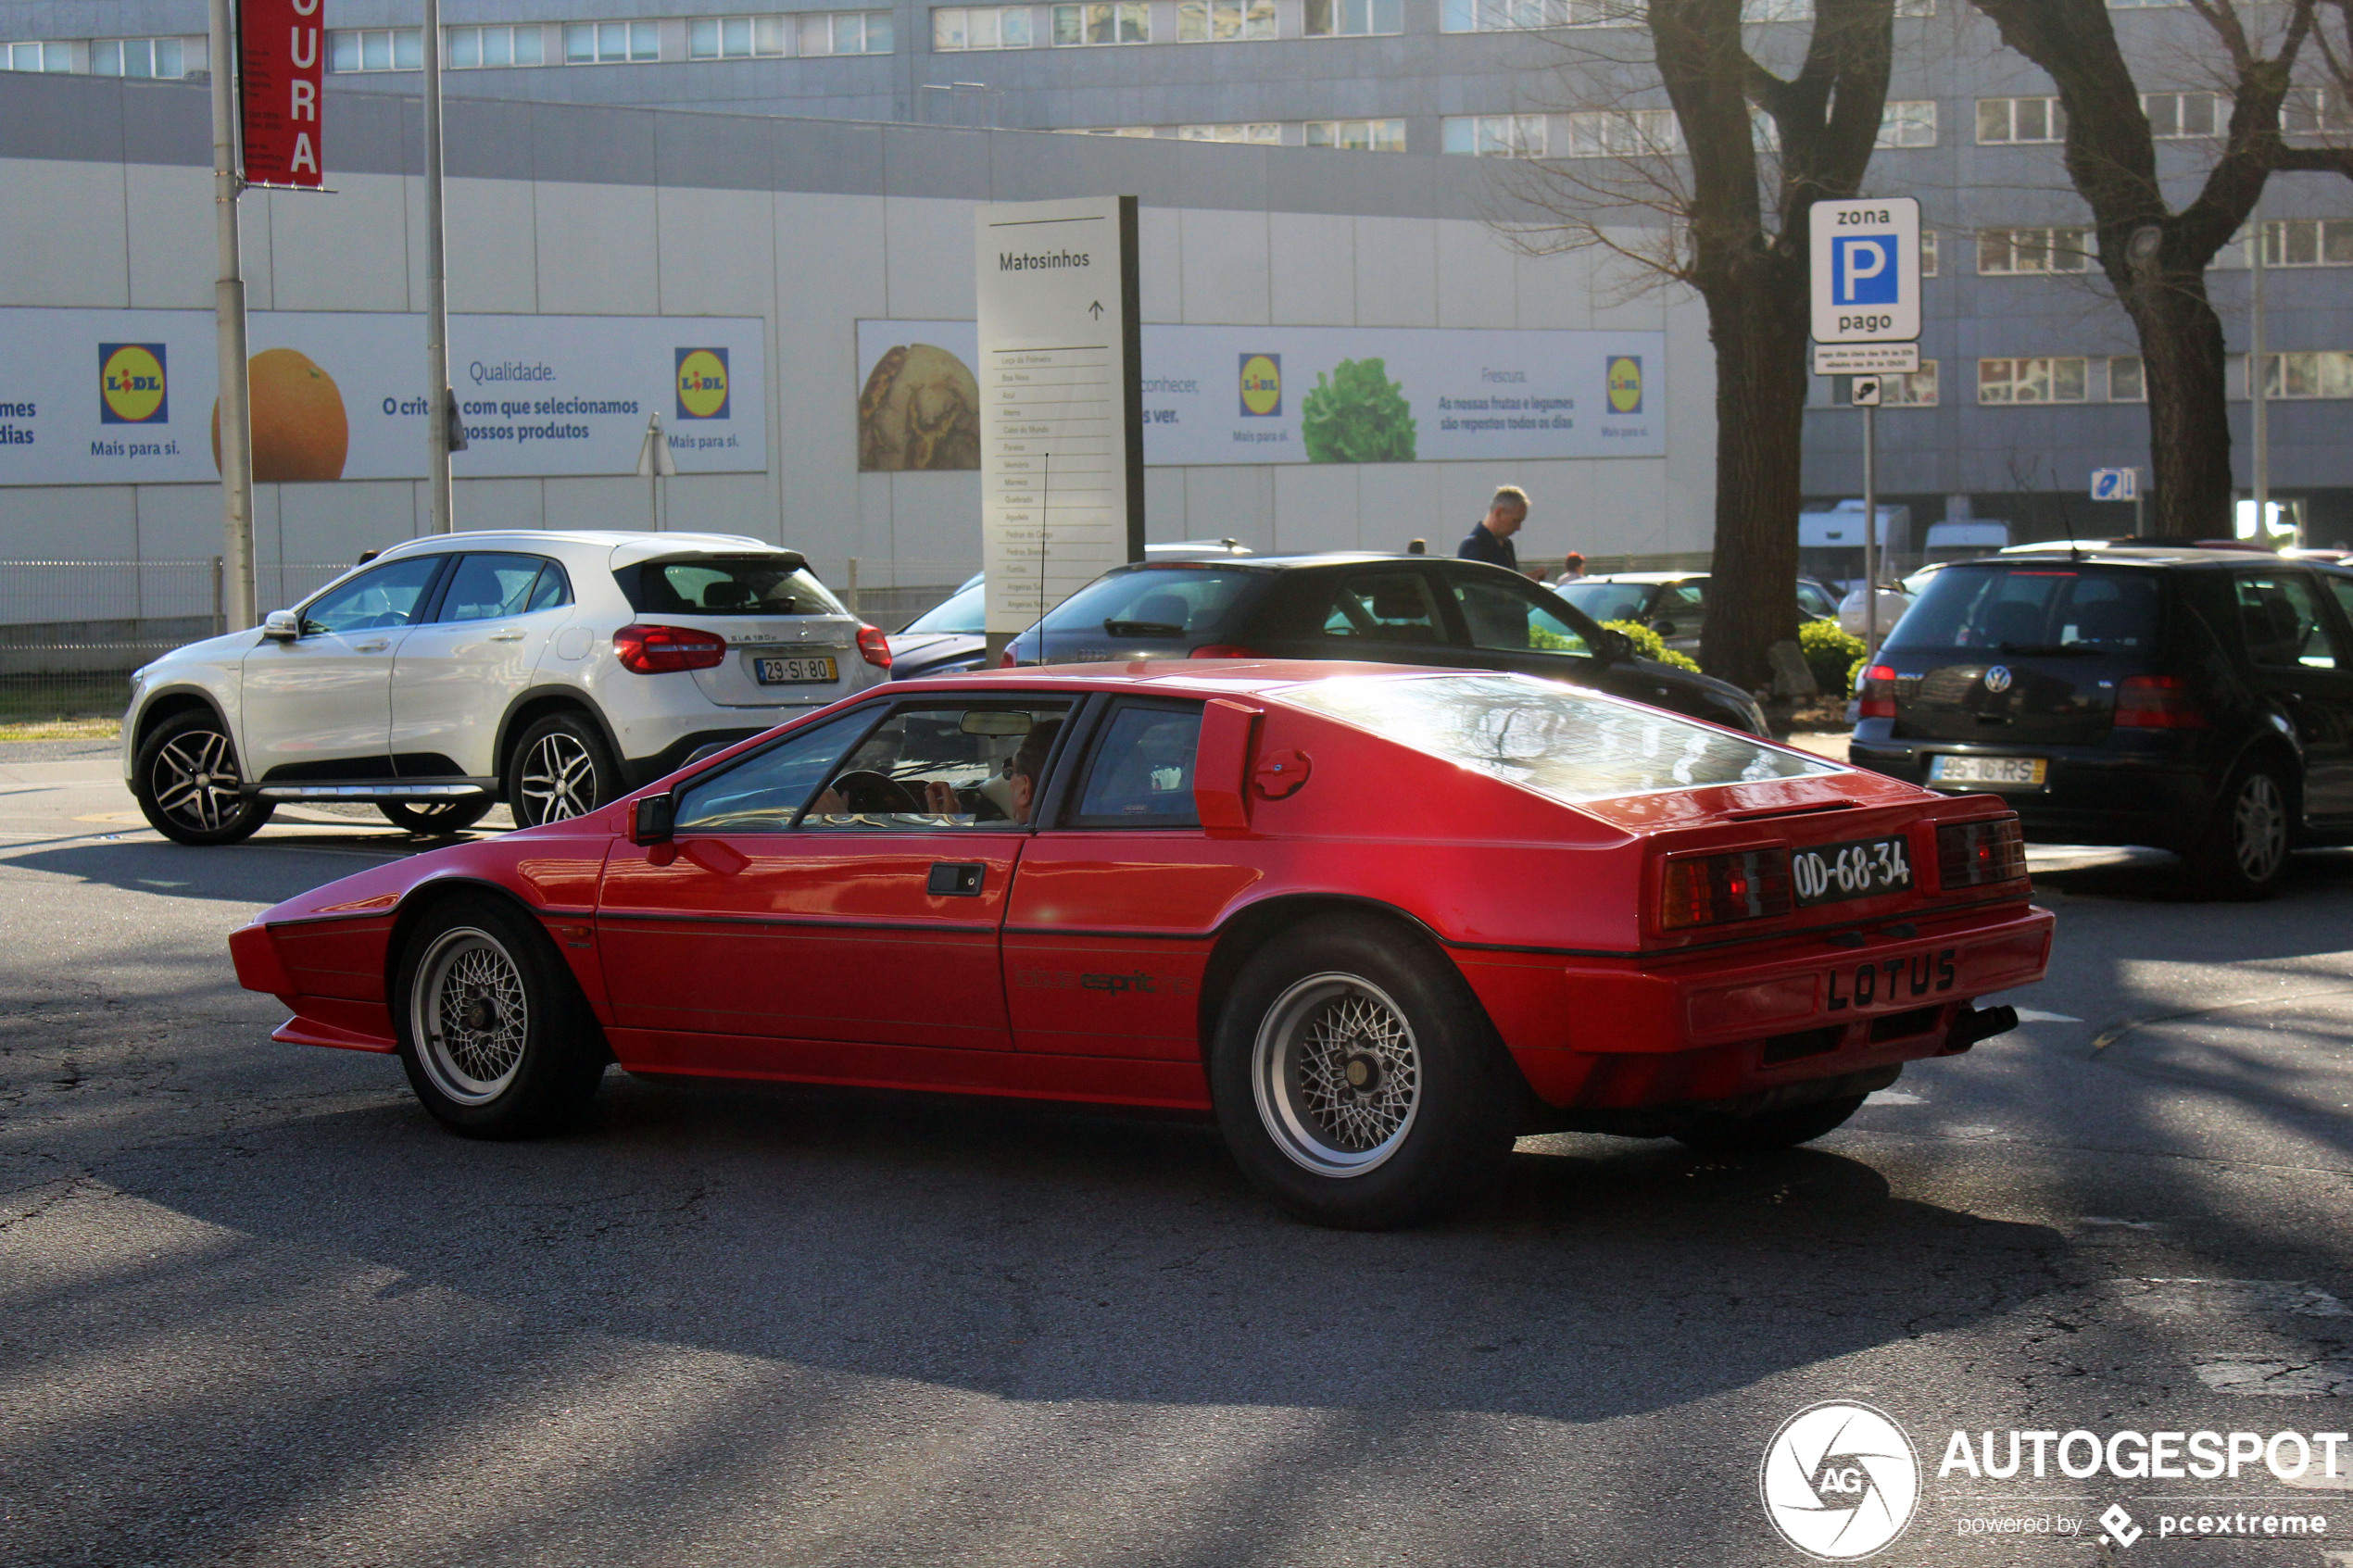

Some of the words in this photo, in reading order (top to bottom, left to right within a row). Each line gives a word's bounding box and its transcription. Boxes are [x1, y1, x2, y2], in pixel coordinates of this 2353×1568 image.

[1837, 209, 1891, 225] zona
[1000, 248, 1090, 271] Matosinhos
[1843, 241, 1886, 300] P
[1839, 314, 1892, 333] pago
[470, 360, 556, 385] Qualidade.
[383, 397, 396, 415] O
[463, 400, 497, 415] com
[500, 399, 531, 419] que
[534, 396, 638, 415] selecionamos
[1439, 396, 1452, 409] As
[1453, 398, 1489, 410] nossas
[1491, 395, 1520, 409] frutas
[1523, 400, 1529, 409] e
[1530, 395, 1574, 412] legumes
[1153, 410, 1179, 423] ver.
[1441, 416, 1458, 430] são
[1460, 418, 1505, 433] repostos
[1507, 416, 1536, 430] todos
[1538, 418, 1550, 430] os
[1552, 414, 1574, 429] dias
[518, 421, 589, 443] produtos
[668, 434, 696, 448] Mais
[698, 436, 724, 450] para
[727, 433, 739, 446] si.
[1233, 430, 1254, 442] Mais
[1256, 433, 1276, 445] para
[91, 441, 125, 456] Mais
[129, 443, 161, 458] para
[165, 440, 180, 455] si.
[1080, 969, 1156, 997] esprit
[1828, 949, 1956, 1011] LOTUS
